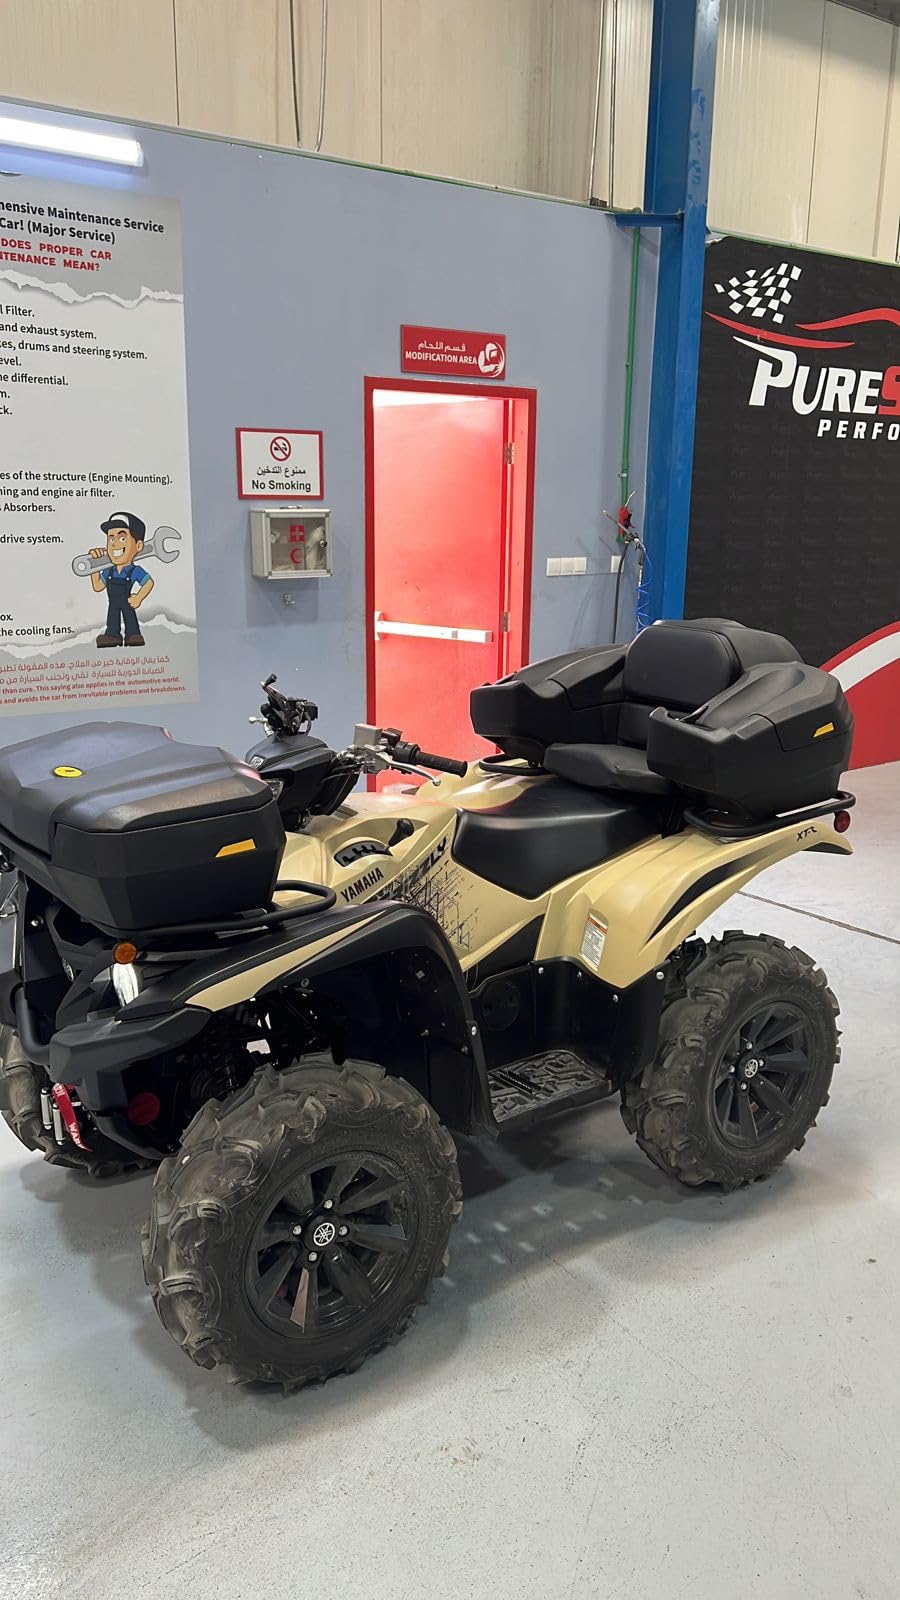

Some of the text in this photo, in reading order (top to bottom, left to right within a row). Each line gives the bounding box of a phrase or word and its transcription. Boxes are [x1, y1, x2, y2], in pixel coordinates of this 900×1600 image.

[47, 206, 121, 227] Maintenance
[124, 217, 164, 233] Service
[0, 217, 115, 245] Car! (Major Service)
[1, 238, 112, 261] DOES PROPER CAR
[63, 259, 100, 272] MEAN?
[5, 305, 35, 317] Filter.
[0, 323, 97, 340] and exhaust system.
[18, 340, 50, 352] drums
[52, 344, 71, 354] and
[72, 346, 112, 359] steering
[112, 350, 148, 360] system.
[418, 340, 466, 353] قسم اللحام
[405, 351, 478, 365] MODIFICATION AREA
[11, 372, 69, 386] differential.
[816, 419, 900, 441] PERFO
[0, 470, 173, 485] es of the structure (Engine Mounting).
[256, 465, 307, 478] ممنوع التدخين
[20, 486, 39, 497] and
[41, 487, 74, 498] engine
[75, 488, 89, 497] air
[90, 487, 115, 498] filter.
[251, 480, 311, 493] No Smoking
[3, 502, 56, 512] Absorbers.
[0, 534, 64, 545] drive system.
[15, 626, 51, 638] cooling
[52, 625, 75, 634] fans.
[50, 684, 71, 692] saying
[85, 681, 108, 689] applies
[17, 695, 39, 703] avoids
[78, 690, 109, 699] inevitable
[109, 688, 138, 697] problems
[340, 867, 384, 903] YAMAHA
